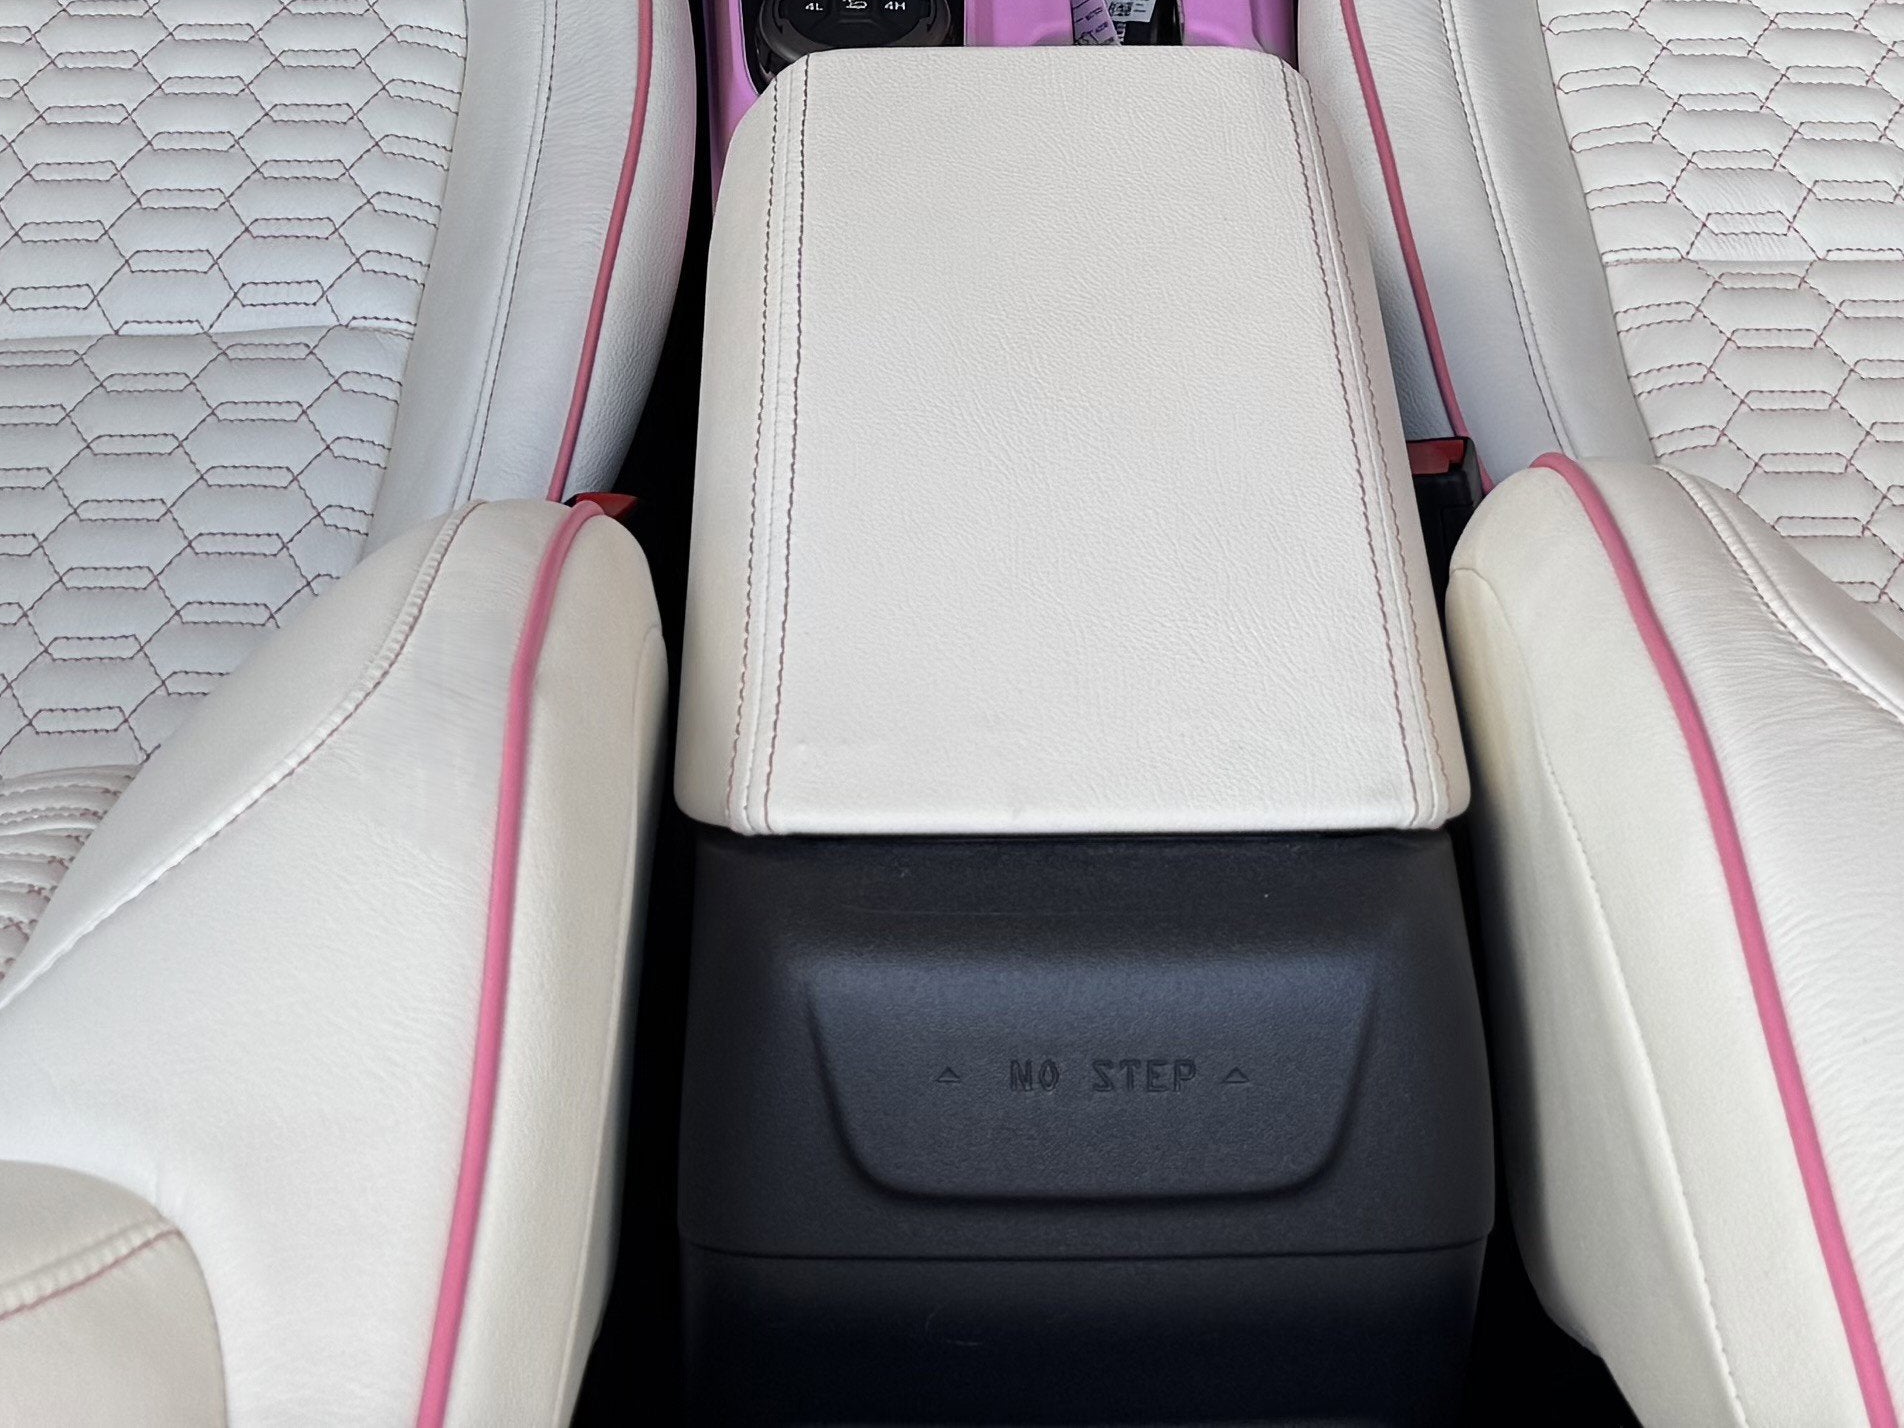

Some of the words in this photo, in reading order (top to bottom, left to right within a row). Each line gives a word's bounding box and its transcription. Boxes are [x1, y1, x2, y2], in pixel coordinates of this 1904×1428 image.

[805, 2, 823, 11] 4L
[884, 1, 906, 10] 4H
[1010, 1058, 1060, 1093] NO
[1093, 1059, 1196, 1093] STEP
